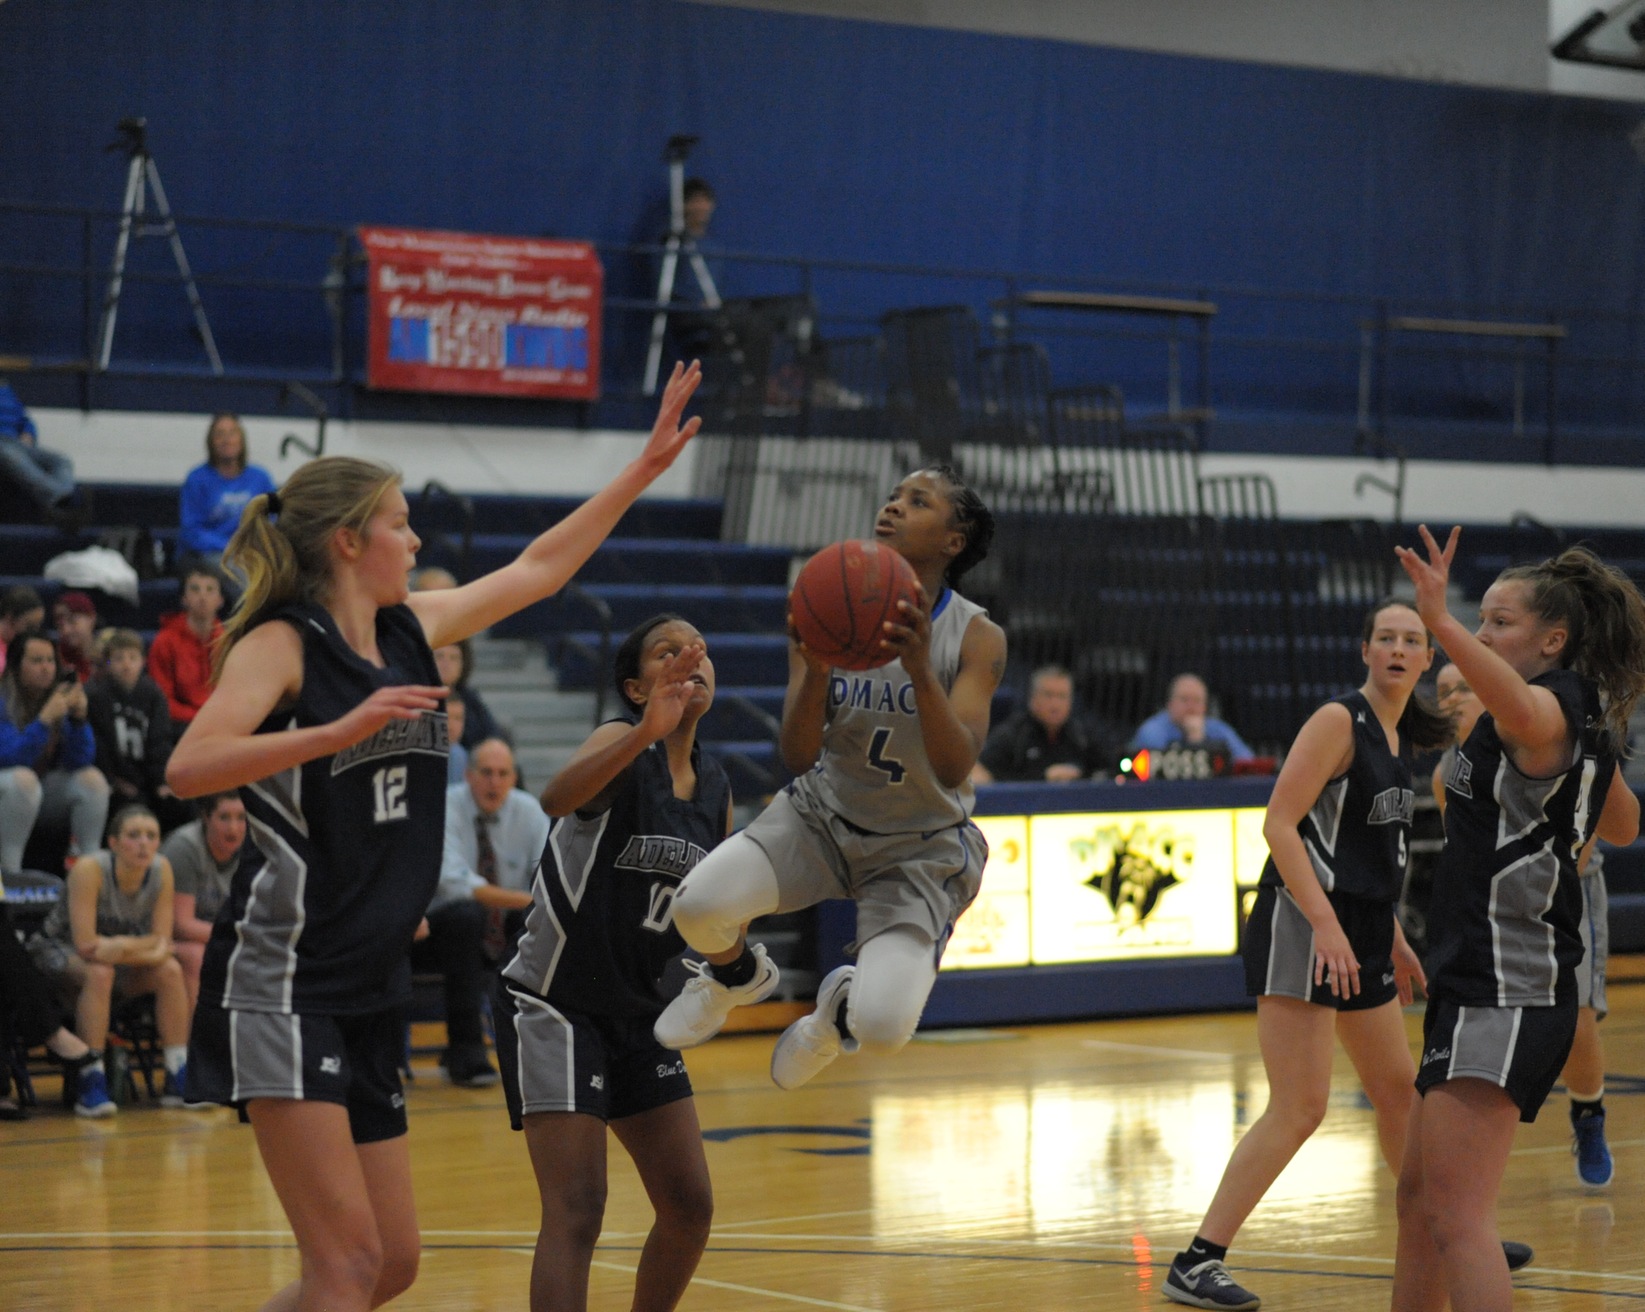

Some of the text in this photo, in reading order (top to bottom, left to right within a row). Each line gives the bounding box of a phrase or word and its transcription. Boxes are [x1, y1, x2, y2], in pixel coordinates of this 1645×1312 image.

[866, 727, 907, 786] 4
[372, 766, 408, 822] 12
[642, 882, 677, 933] 10
